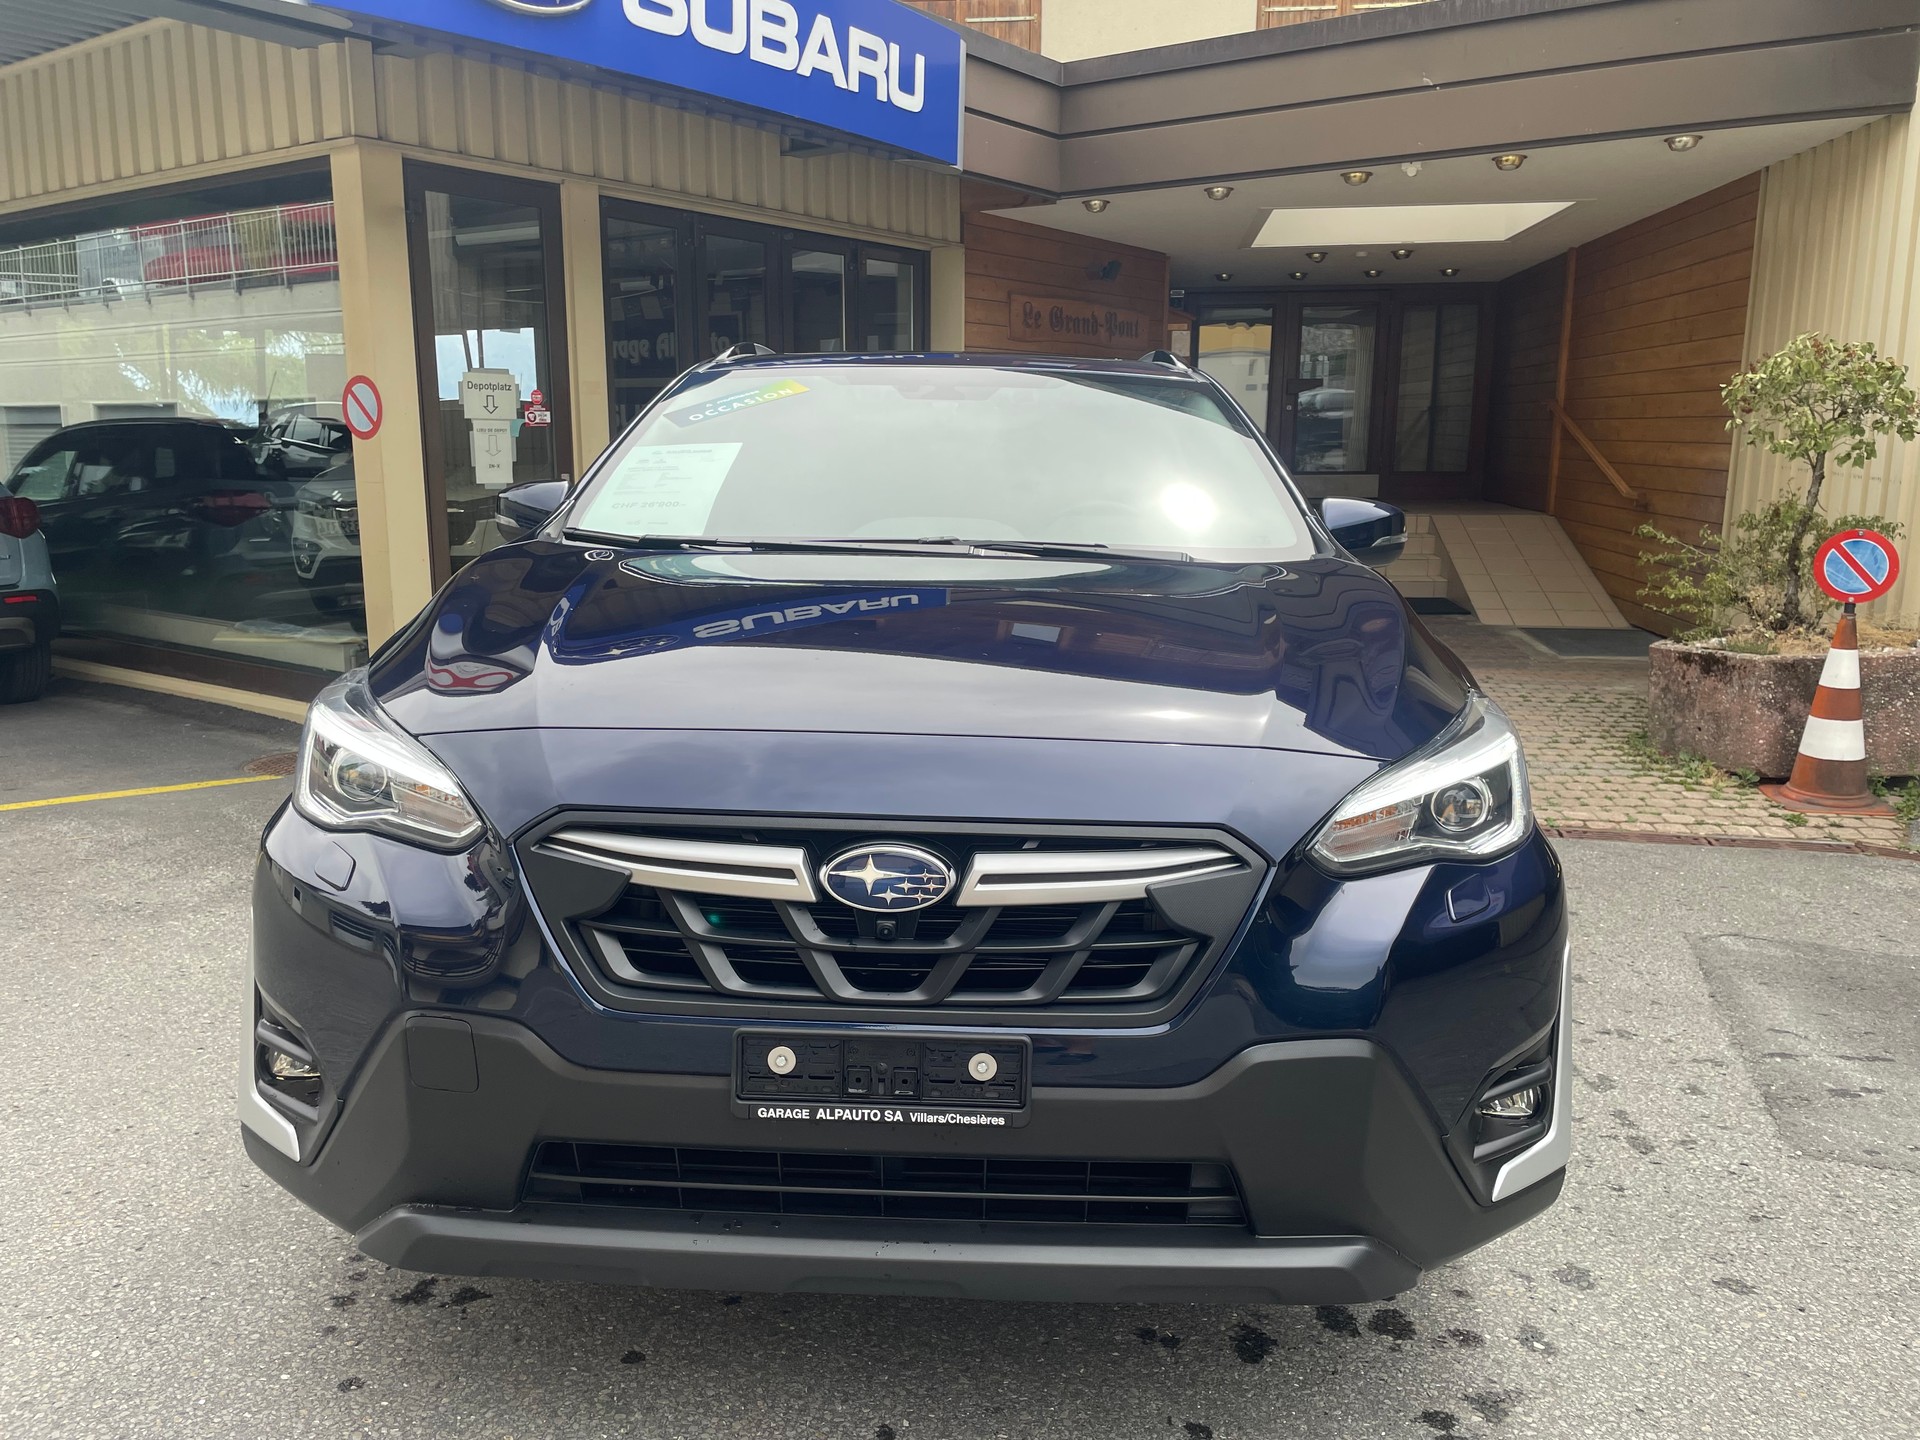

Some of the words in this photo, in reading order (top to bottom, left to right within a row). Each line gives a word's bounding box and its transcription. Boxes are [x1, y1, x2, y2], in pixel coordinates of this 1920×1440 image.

[1022, 301, 1042, 329] Le
[1049, 305, 1140, 344] Grand-Pont
[467, 381, 512, 392] Depotplatz
[688, 388, 794, 422] OCCASION
[611, 502, 638, 510] CHF
[757, 1107, 810, 1120] GARAGE
[816, 1108, 881, 1122] ALPAUTO
[884, 1109, 904, 1122] SA
[909, 1111, 1006, 1126] Villars/Chesières
